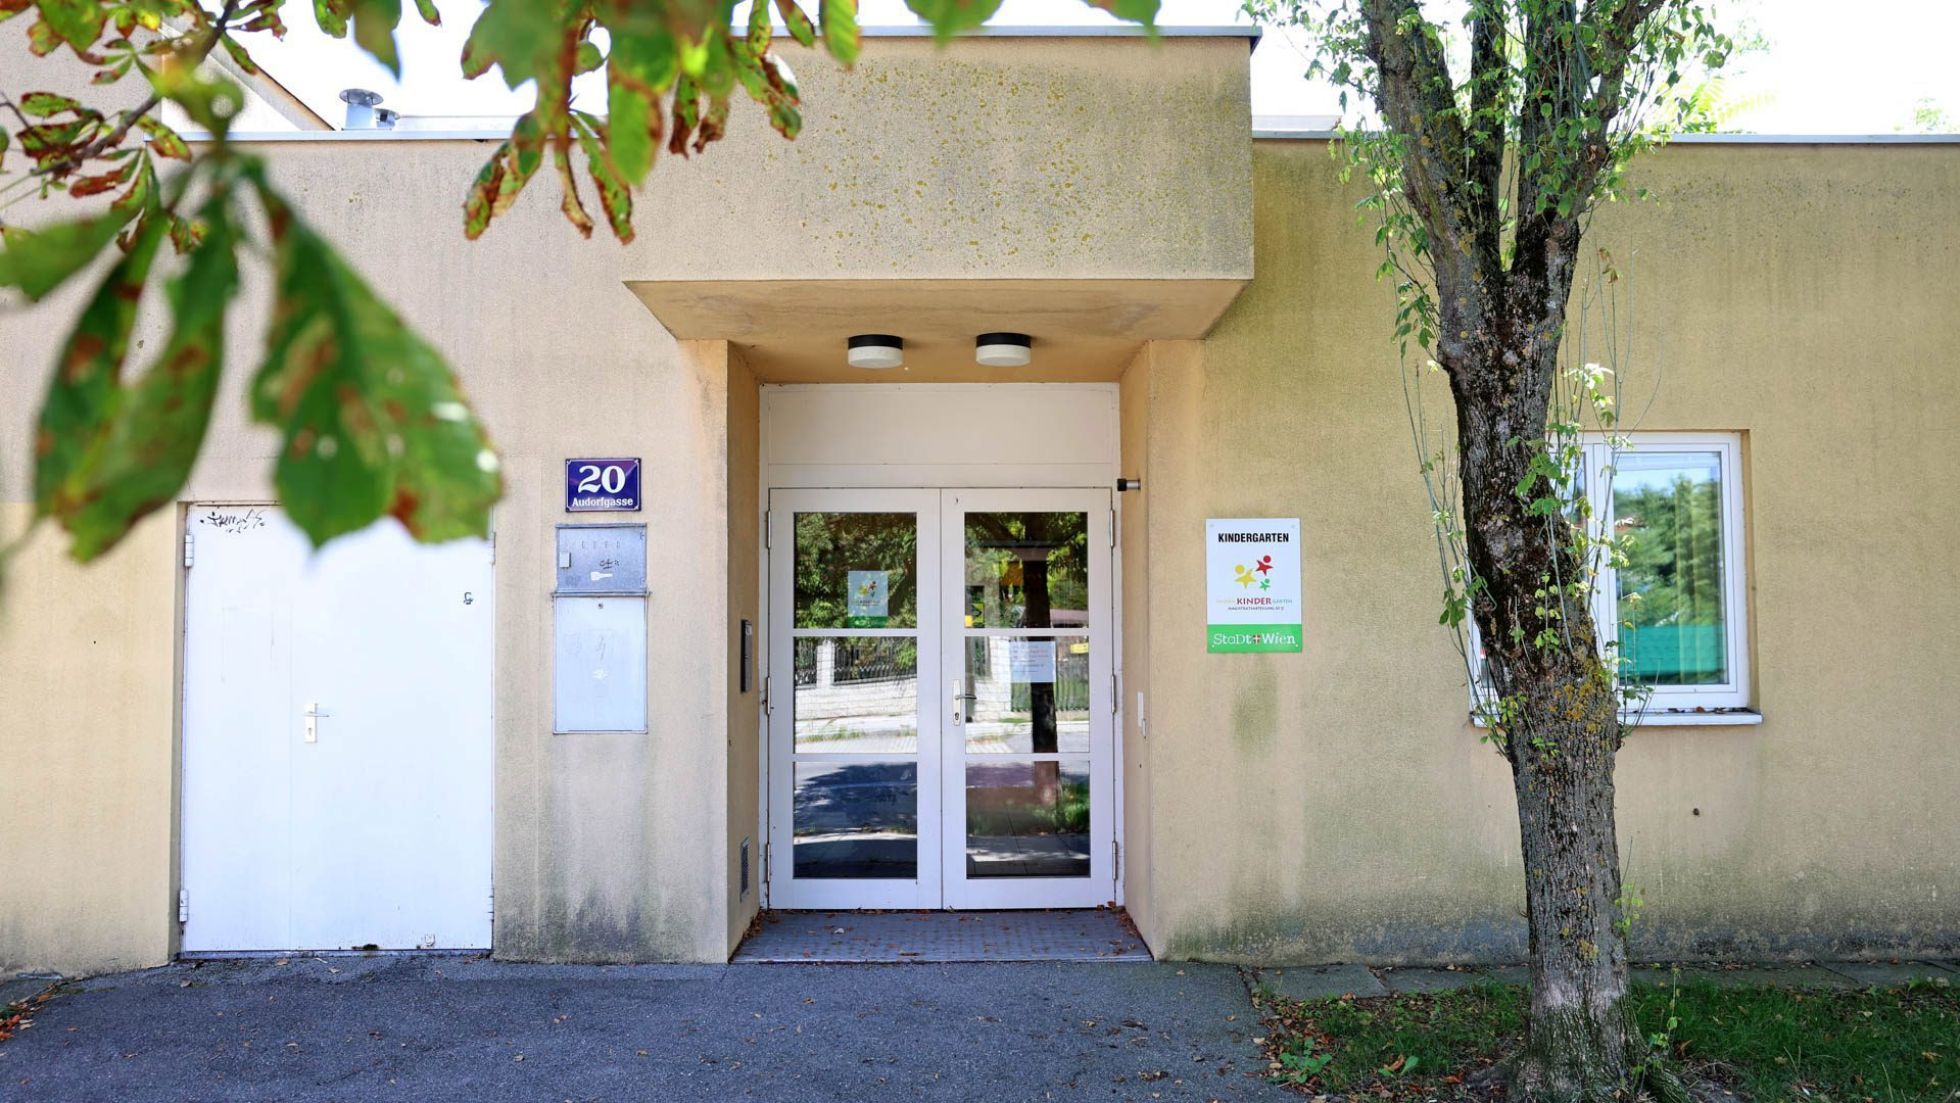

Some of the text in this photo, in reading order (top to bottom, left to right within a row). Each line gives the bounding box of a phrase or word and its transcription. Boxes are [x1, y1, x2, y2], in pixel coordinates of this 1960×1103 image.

[577, 465, 626, 494] 20
[572, 497, 634, 508] Audorfgasse
[1218, 533, 1289, 543] KINDERGARTEN
[1236, 597, 1272, 605] KINDER
[1262, 632, 1296, 645] Wien
